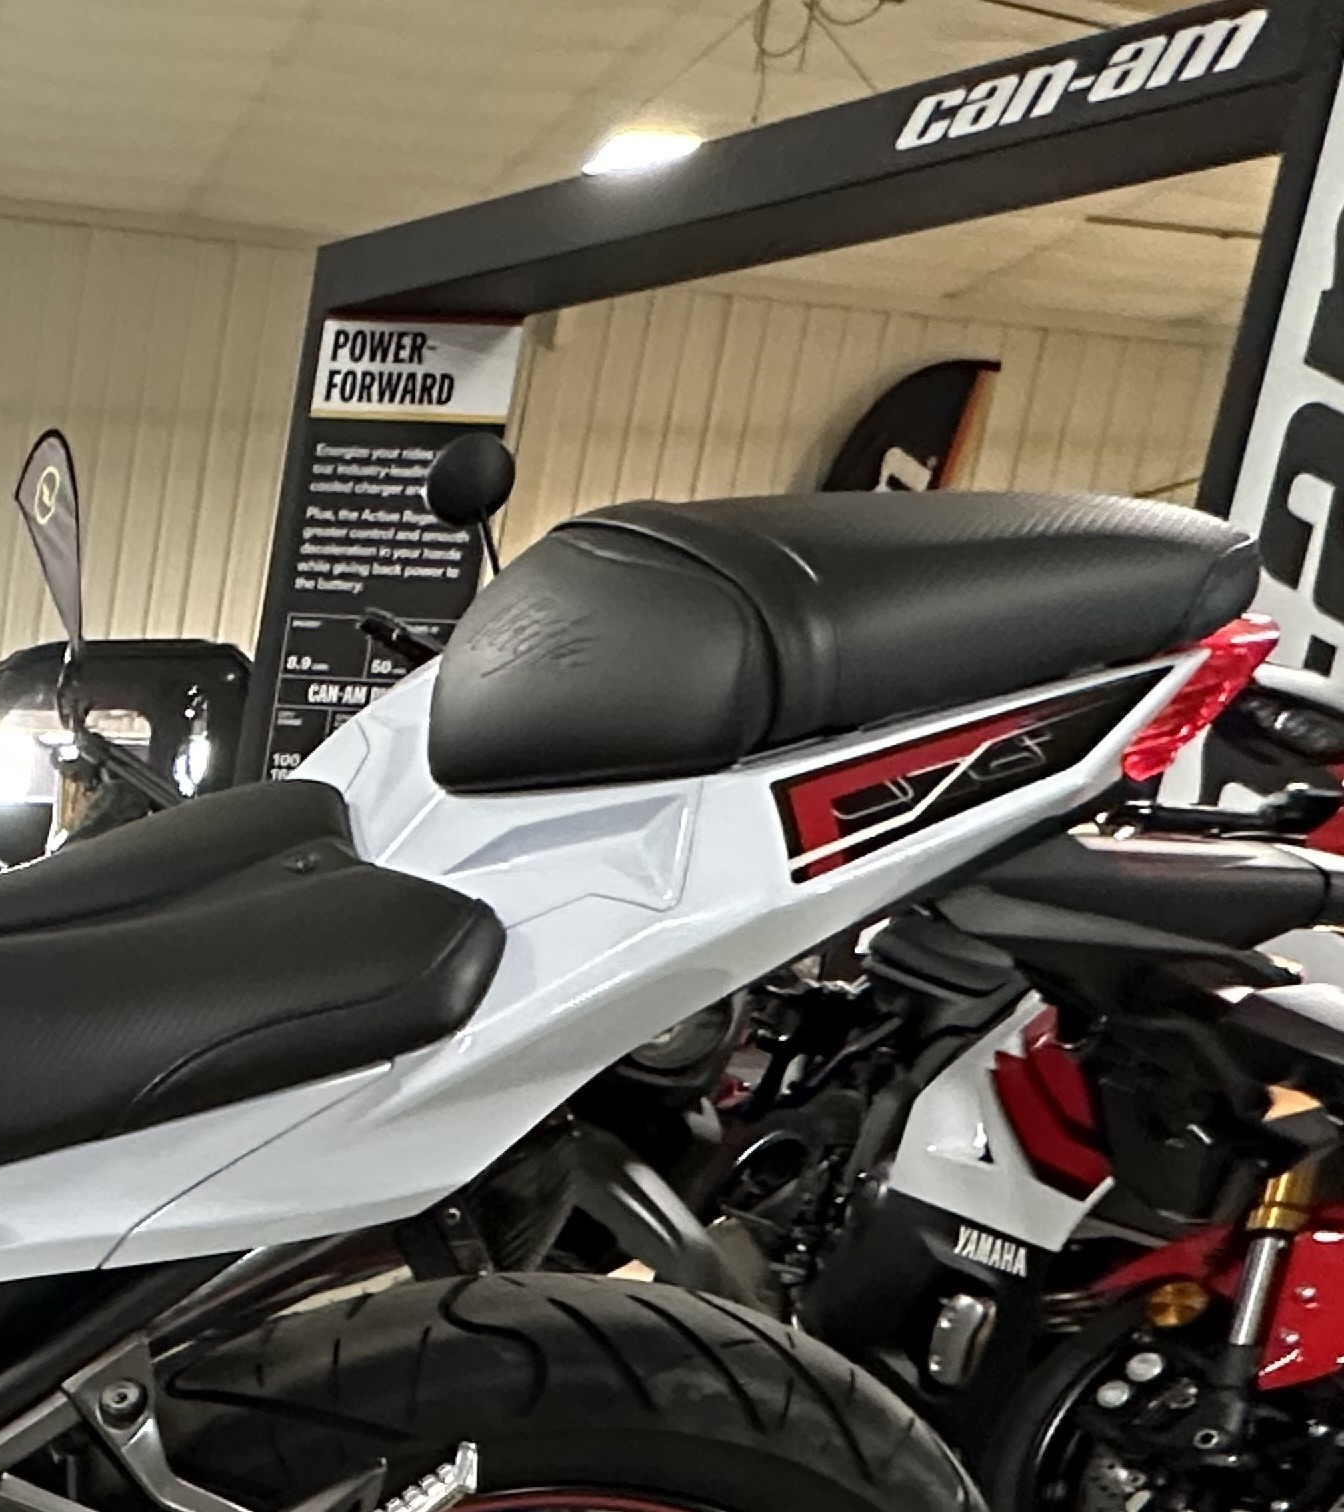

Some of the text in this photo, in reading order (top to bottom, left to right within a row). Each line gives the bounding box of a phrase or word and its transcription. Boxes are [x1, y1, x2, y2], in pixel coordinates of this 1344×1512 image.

[895, 10, 1268, 151] can-am
[330, 328, 438, 365] POWER-
[324, 369, 454, 405] FORWARD
[371, 448, 400, 460] your
[338, 509, 359, 521] the
[349, 527, 395, 540] control
[395, 529, 421, 541] and
[378, 545, 391, 557] in
[392, 548, 421, 560] your
[296, 562, 330, 572] while
[372, 562, 402, 576] back
[403, 565, 444, 578] power
[446, 566, 460, 578] to
[294, 577, 315, 589] the
[308, 682, 368, 704] CAN-AM
[953, 1224, 1027, 1278] YAMAHA
